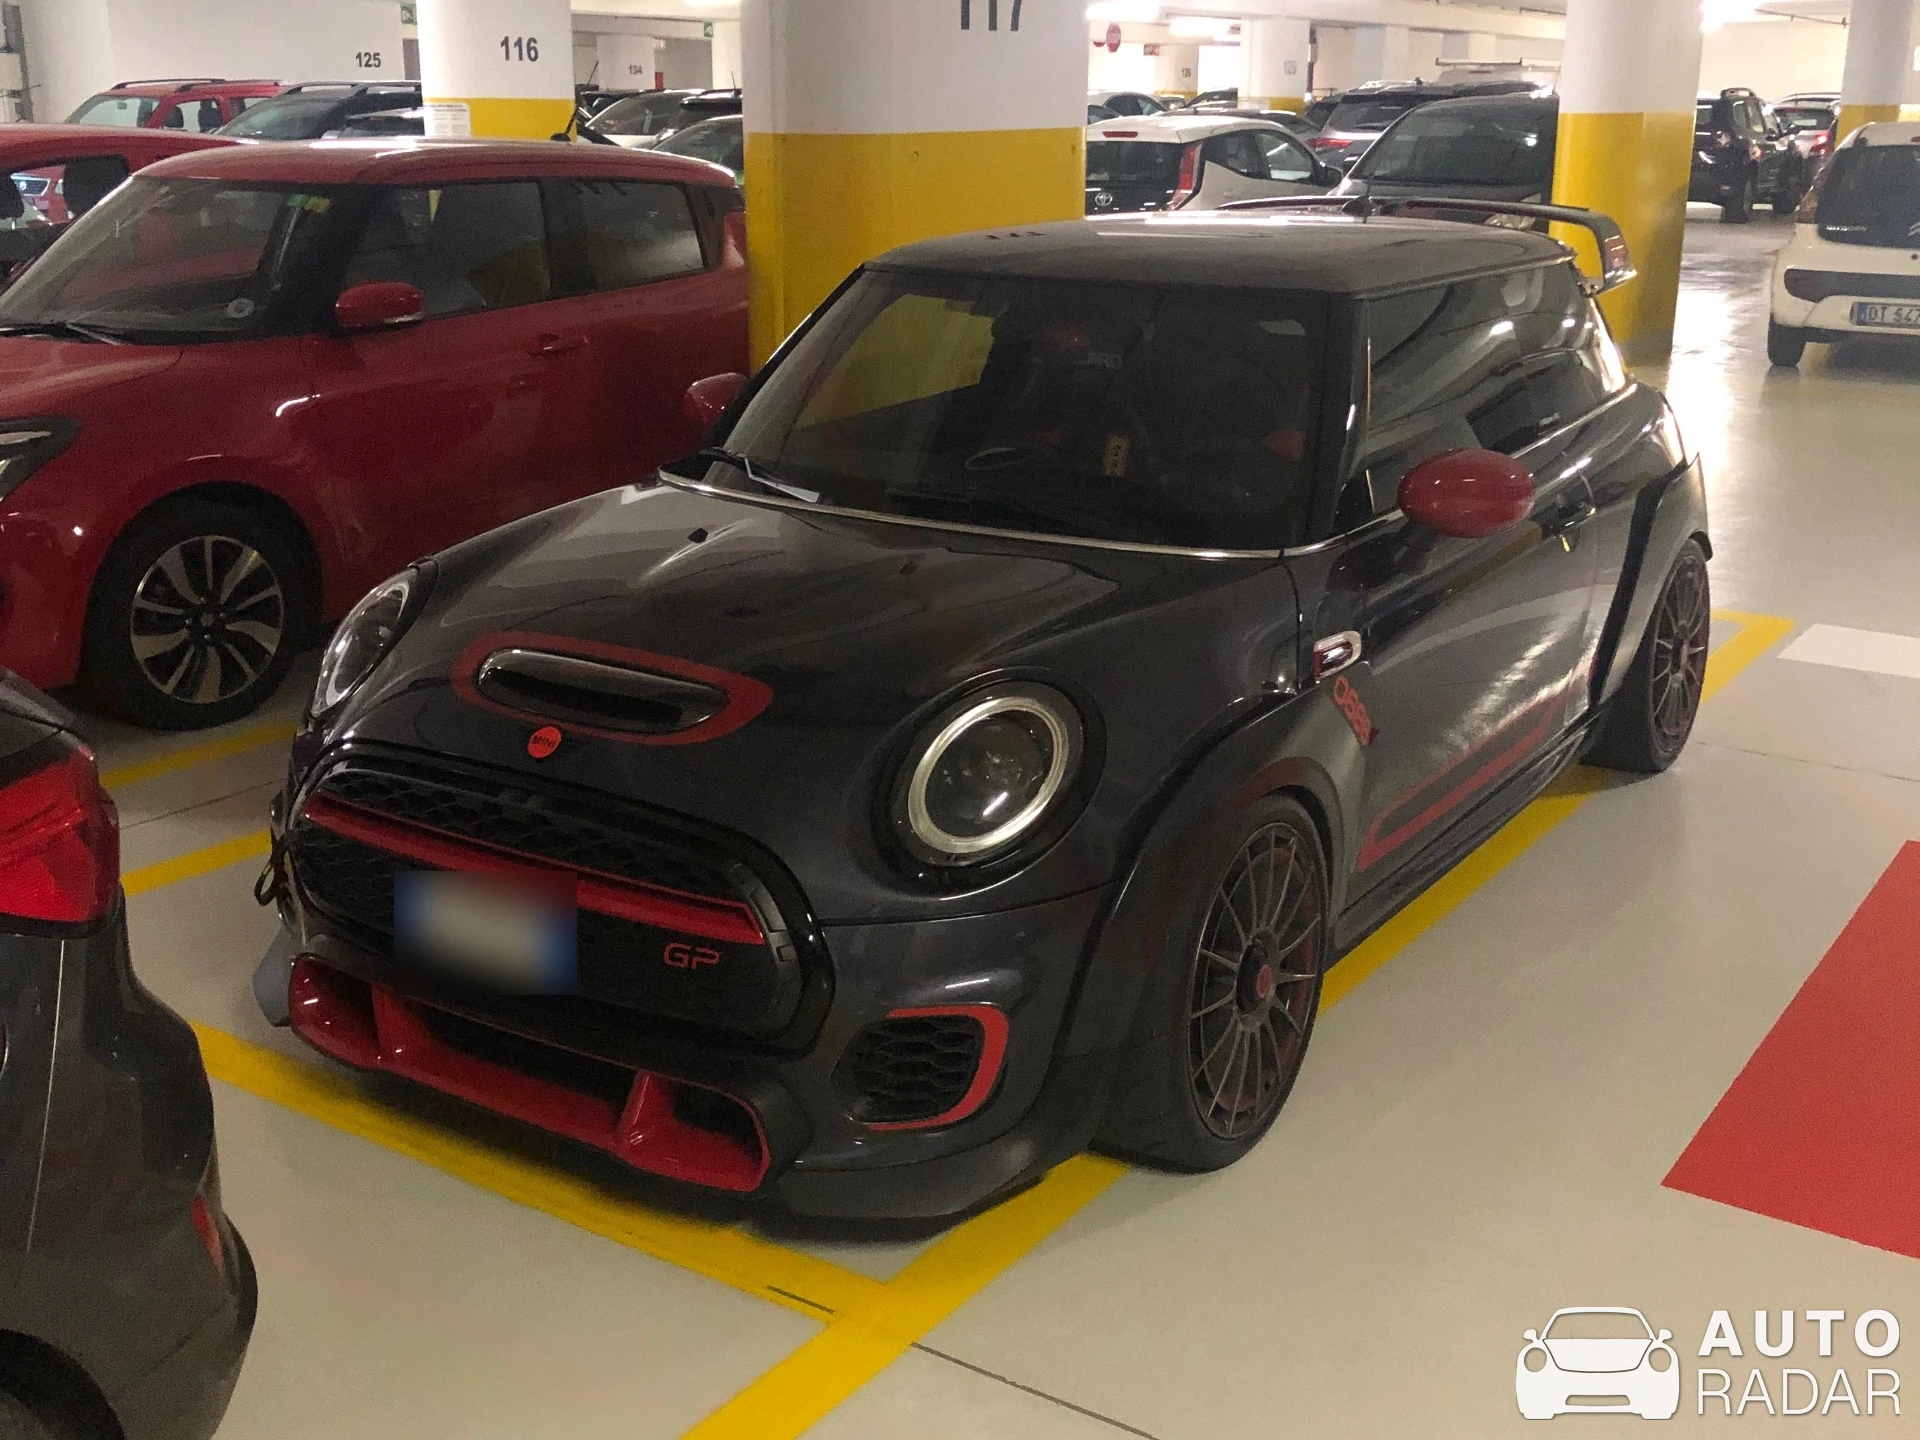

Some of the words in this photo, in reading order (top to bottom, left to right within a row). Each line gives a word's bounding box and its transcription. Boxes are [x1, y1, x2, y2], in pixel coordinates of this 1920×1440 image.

[355, 51, 382, 68] 125
[500, 36, 539, 62] 116
[664, 942, 721, 970] GP
